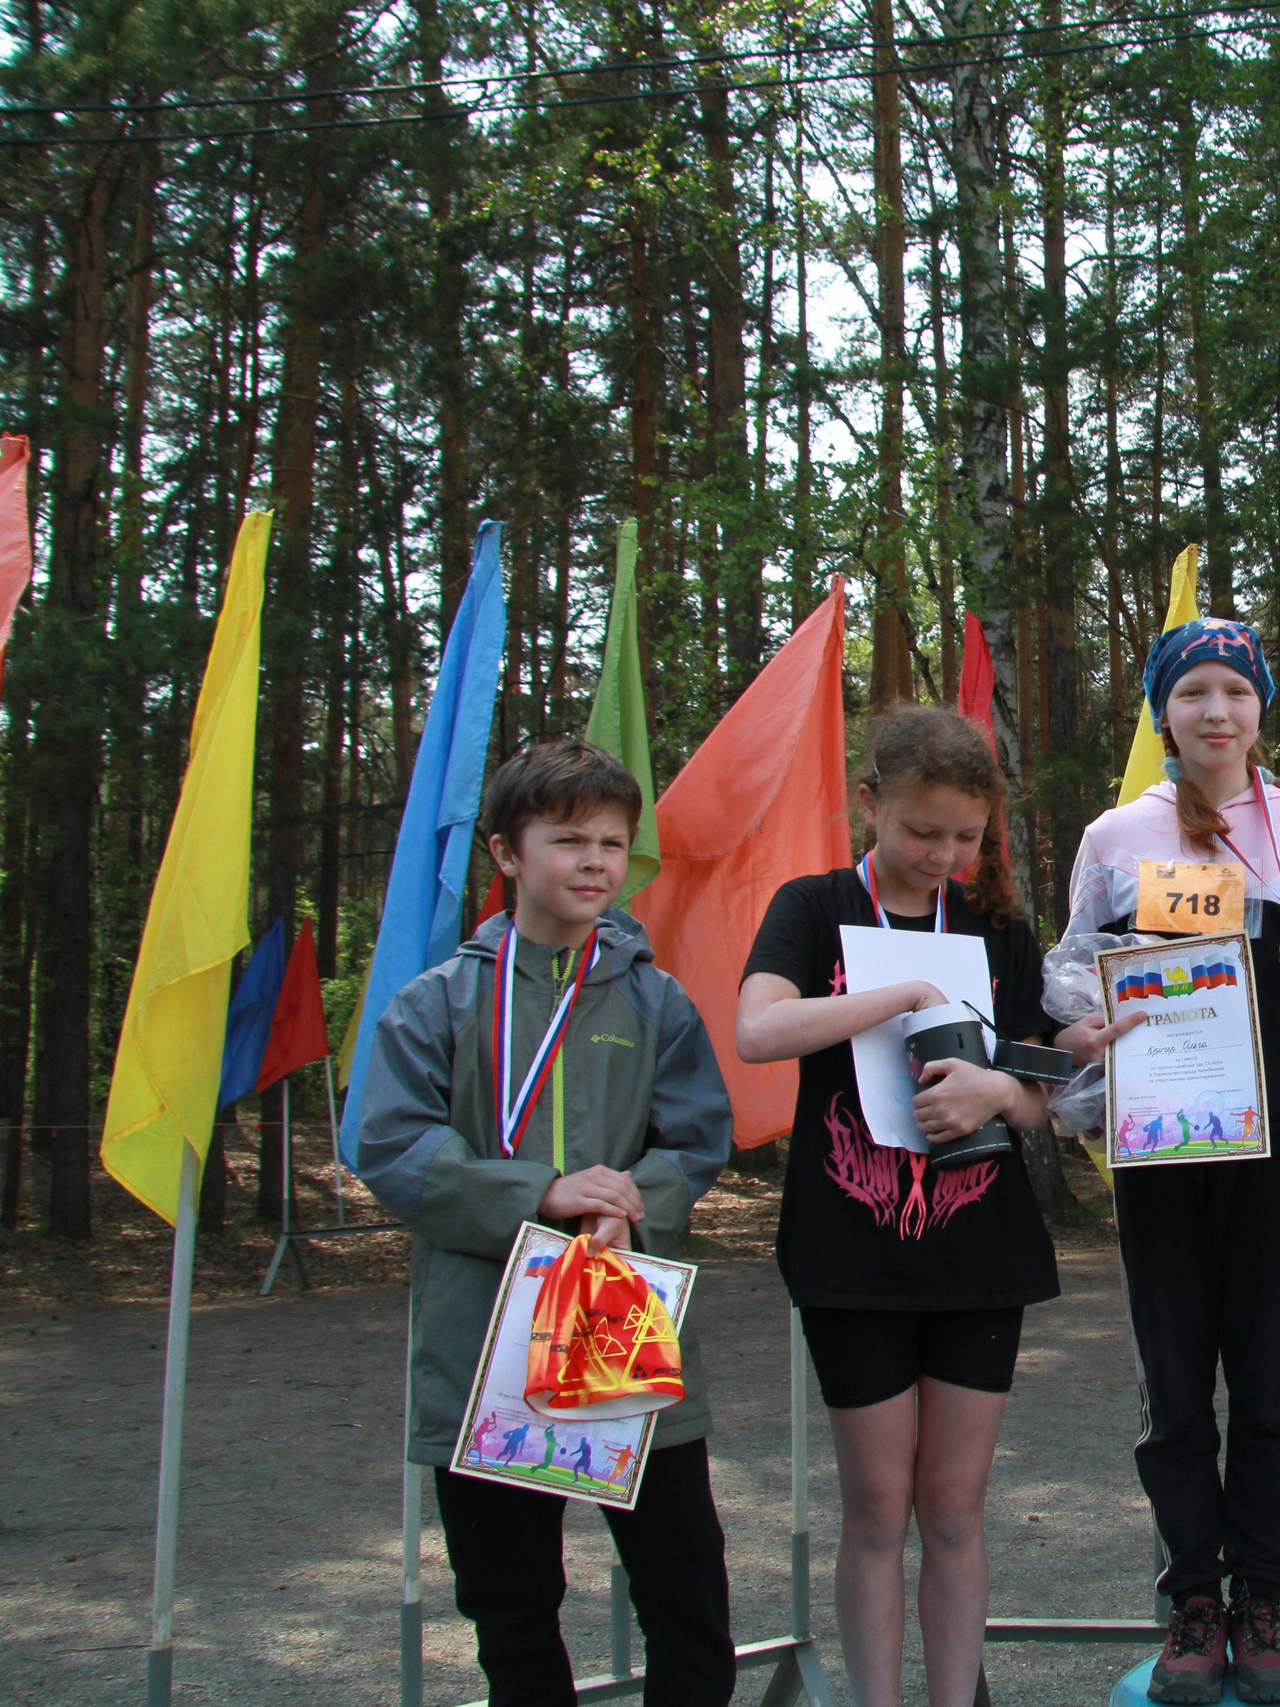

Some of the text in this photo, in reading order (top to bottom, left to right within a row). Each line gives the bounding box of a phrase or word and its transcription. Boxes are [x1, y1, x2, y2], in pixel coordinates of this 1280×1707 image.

[1166, 892, 1220, 916] 718
[1145, 1006, 1218, 1027] ГРАМОТА
[652, 1367, 682, 1378] FIS
